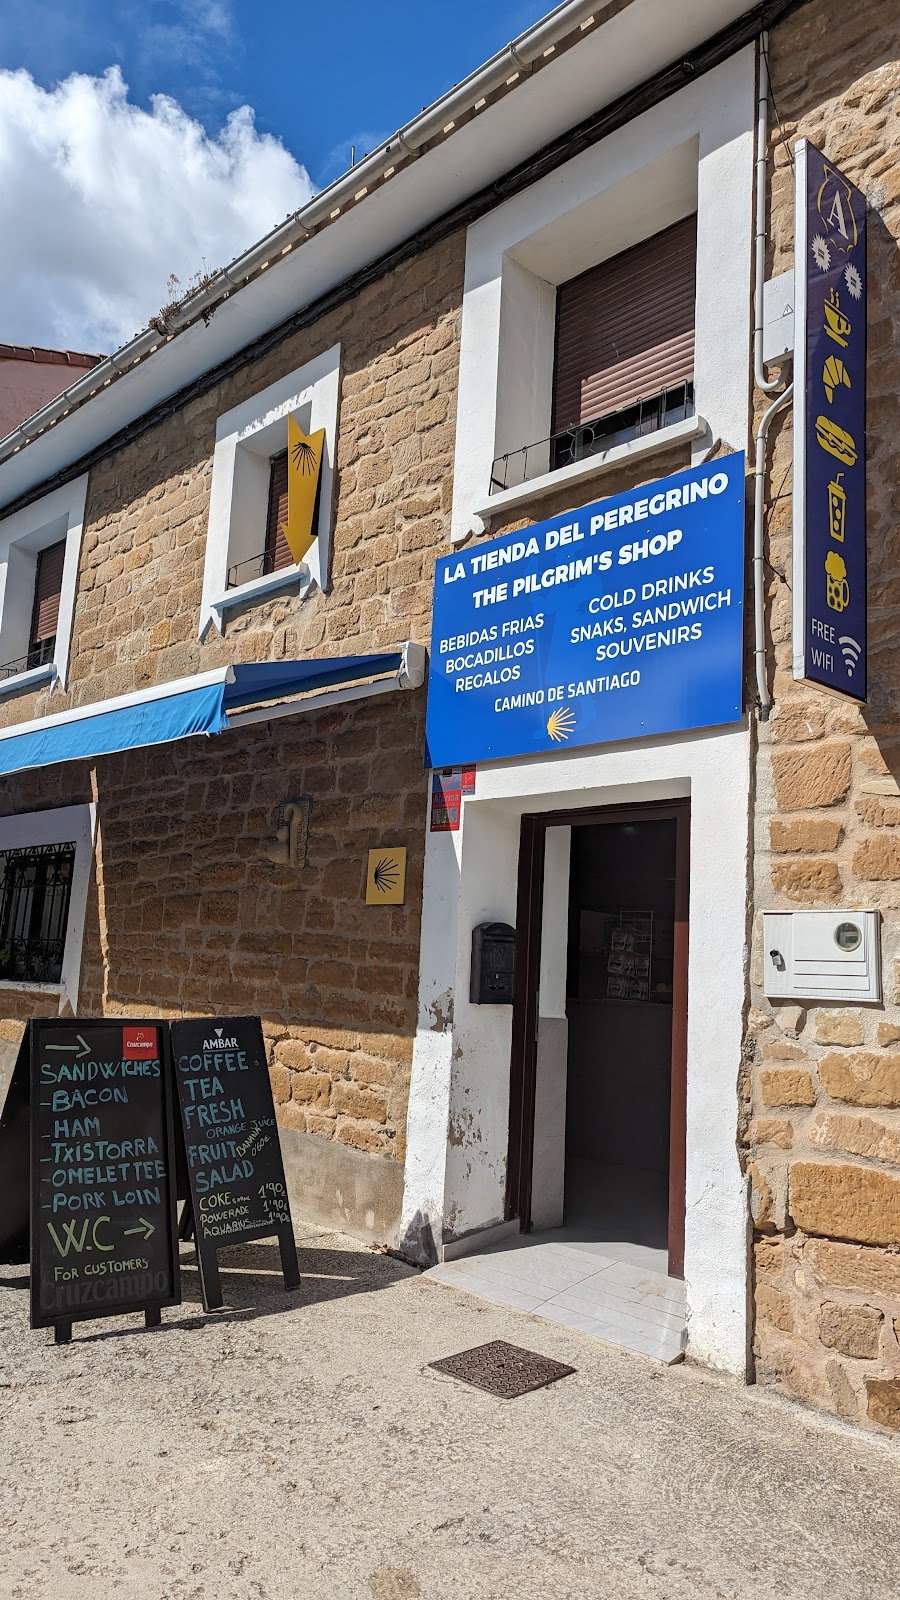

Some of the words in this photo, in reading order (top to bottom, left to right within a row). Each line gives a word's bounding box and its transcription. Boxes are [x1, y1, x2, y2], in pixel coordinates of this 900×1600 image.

[443, 566, 466, 584] LA
[470, 538, 539, 575] TIENDA
[545, 523, 584, 550] DEL
[590, 472, 729, 536] PEREGRINO
[472, 583, 507, 608] THE
[513, 550, 612, 597] PILGRIM'S
[618, 529, 683, 564] SHOP
[588, 588, 636, 614] COLD
[641, 566, 715, 600] DRINKS
[570, 617, 627, 644] SNAKS,
[632, 589, 731, 629] SANDWICH
[440, 625, 498, 654] BEBIDAS
[501, 613, 544, 637] FRIAS
[596, 623, 702, 661] SOUVENIRS
[812, 618, 835, 644] FREE
[446, 639, 534, 673] BOCADILLOS
[811, 647, 833, 672] WIFI
[455, 665, 521, 692] REGALOS
[494, 690, 544, 712] CAMINO
[548, 685, 564, 702] DE
[568, 670, 640, 698] SANTIAGO
[434, 794, 458, 803] Alarma
[126, 1041, 153, 1049] Cruzcampo
[203, 1038, 239, 1050] AMBAR
[40, 1057, 160, 1084] SANDWICHES
[179, 1051, 249, 1072] COFFEE
[184, 1076, 224, 1101] TEA
[184, 1098, 245, 1130] FRESH
[206, 1122, 247, 1138] ORANGE
[250, 1116, 275, 1130] JUICE
[187, 1138, 237, 1167] FRUIT
[236, 1127, 262, 1157] BANANA
[196, 1159, 254, 1192] SALAD
[113, 1187, 160, 1206] LOIN
[200, 1192, 231, 1211] COKE
[200, 1206, 249, 1228] POWERADE
[203, 1219, 252, 1239] AQUARIUS
[84, 1259, 149, 1275] CUSTOMERS
[40, 1271, 167, 1310] Cruzcampo
